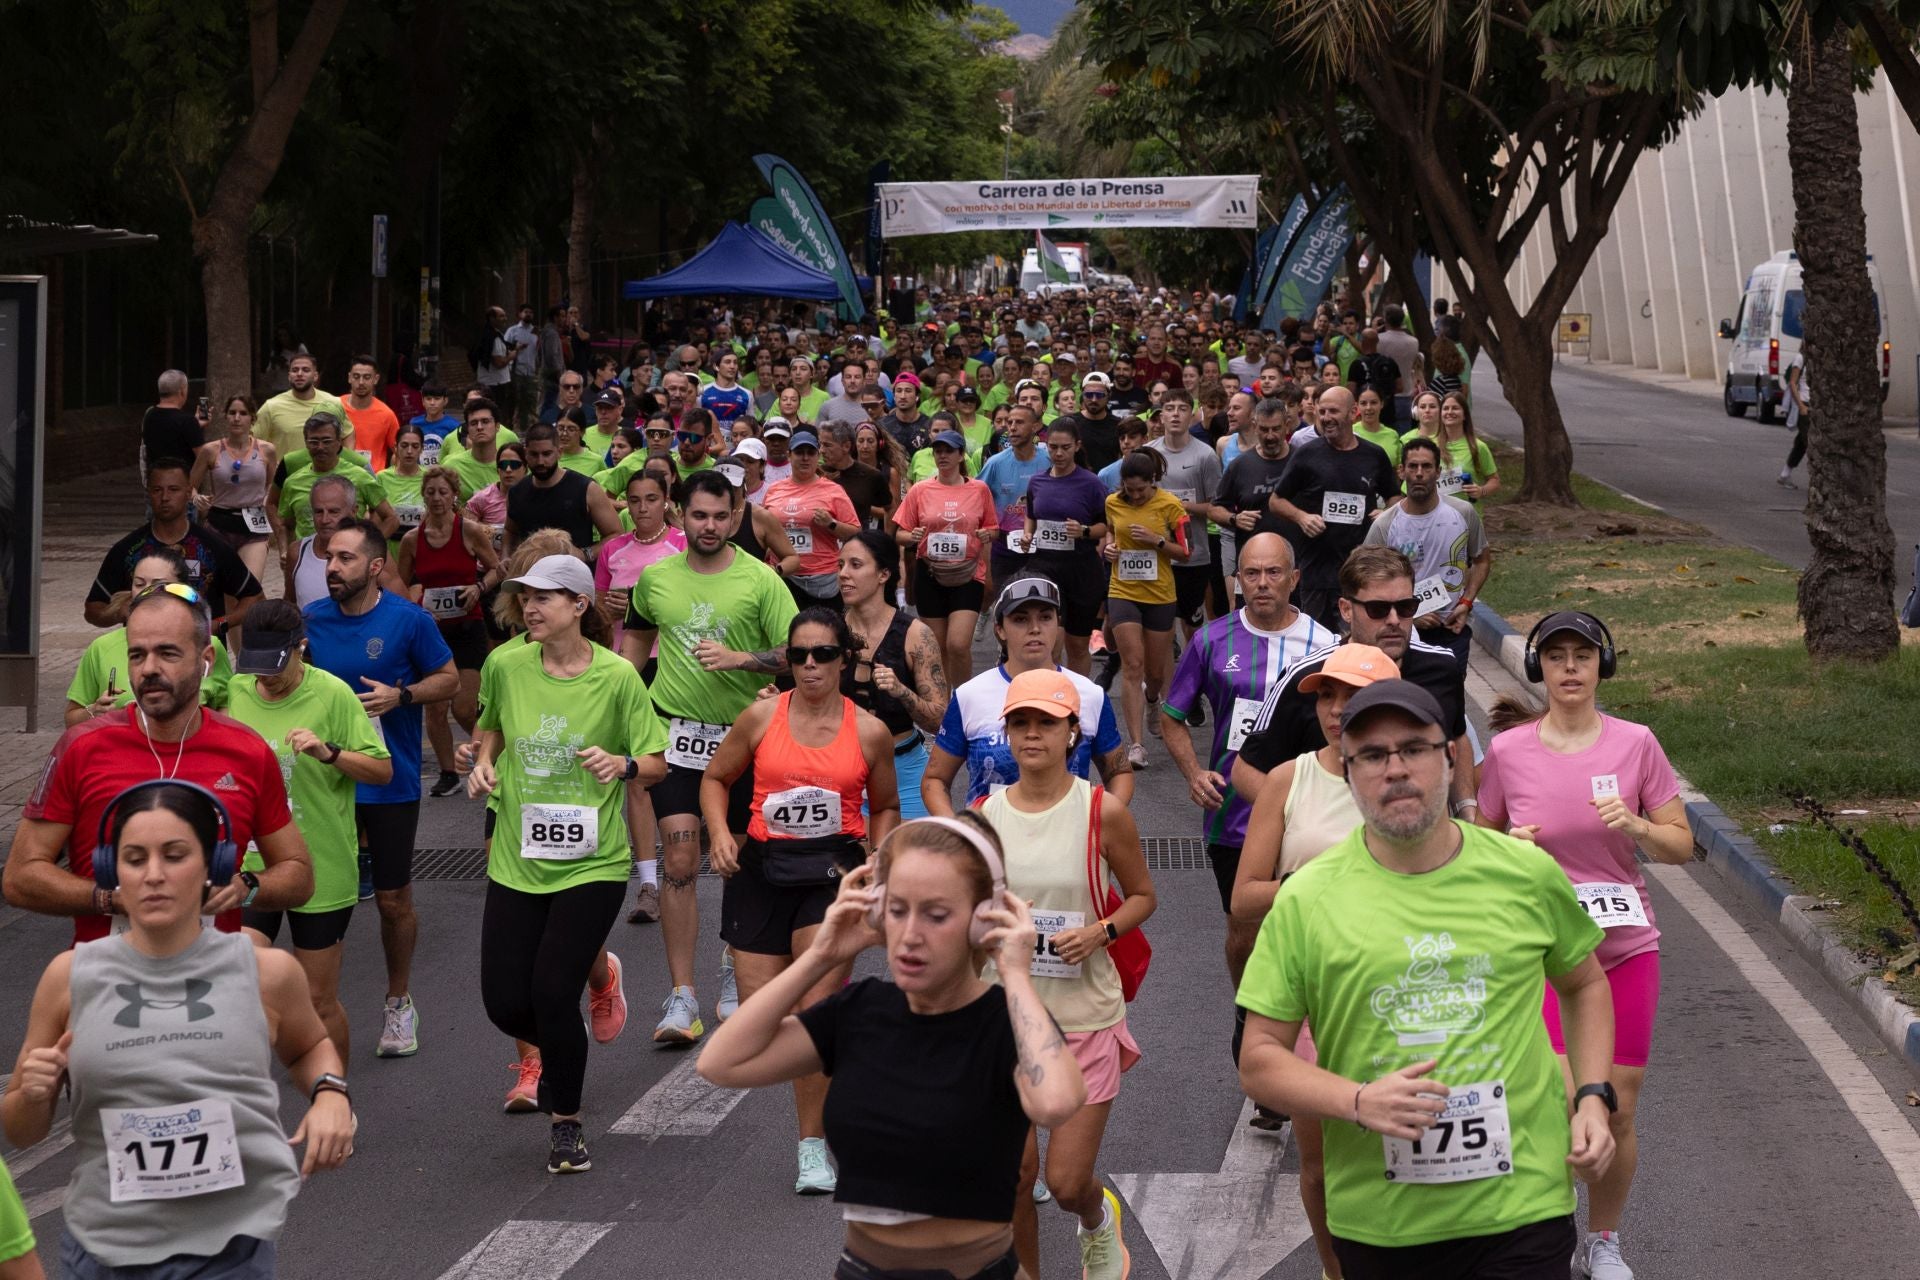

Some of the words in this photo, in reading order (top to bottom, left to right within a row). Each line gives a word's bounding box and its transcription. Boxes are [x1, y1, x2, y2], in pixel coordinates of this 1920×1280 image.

[979, 184, 1047, 199] Carrera
[1053, 182, 1076, 197] de
[1081, 182, 1097, 196] la
[1102, 181, 1164, 196] Prensa
[965, 203, 999, 212] motivo
[1001, 202, 1016, 211] del
[1036, 201, 1074, 211] Mundial
[1076, 201, 1088, 210] de
[1091, 200, 1100, 209] la
[1102, 199, 1142, 209] Libertad
[1144, 199, 1157, 208] de
[1158, 199, 1191, 208] Prensa
[1328, 502, 1358, 515] 928
[251, 516, 267, 526] 84
[788, 535, 806, 545] 90
[1041, 530, 1068, 542] 935
[932, 542, 960, 553] 185
[1121, 559, 1153, 569] 1000
[432, 598, 453, 610] 70
[675, 736, 721, 757] 608
[213, 782, 240, 792] adidas
[773, 803, 829, 824] 475
[531, 823, 584, 843] 869
[105, 1035, 156, 1052] UNDER
[158, 1031, 224, 1044] ARMOUR
[124, 1132, 209, 1171] 177
